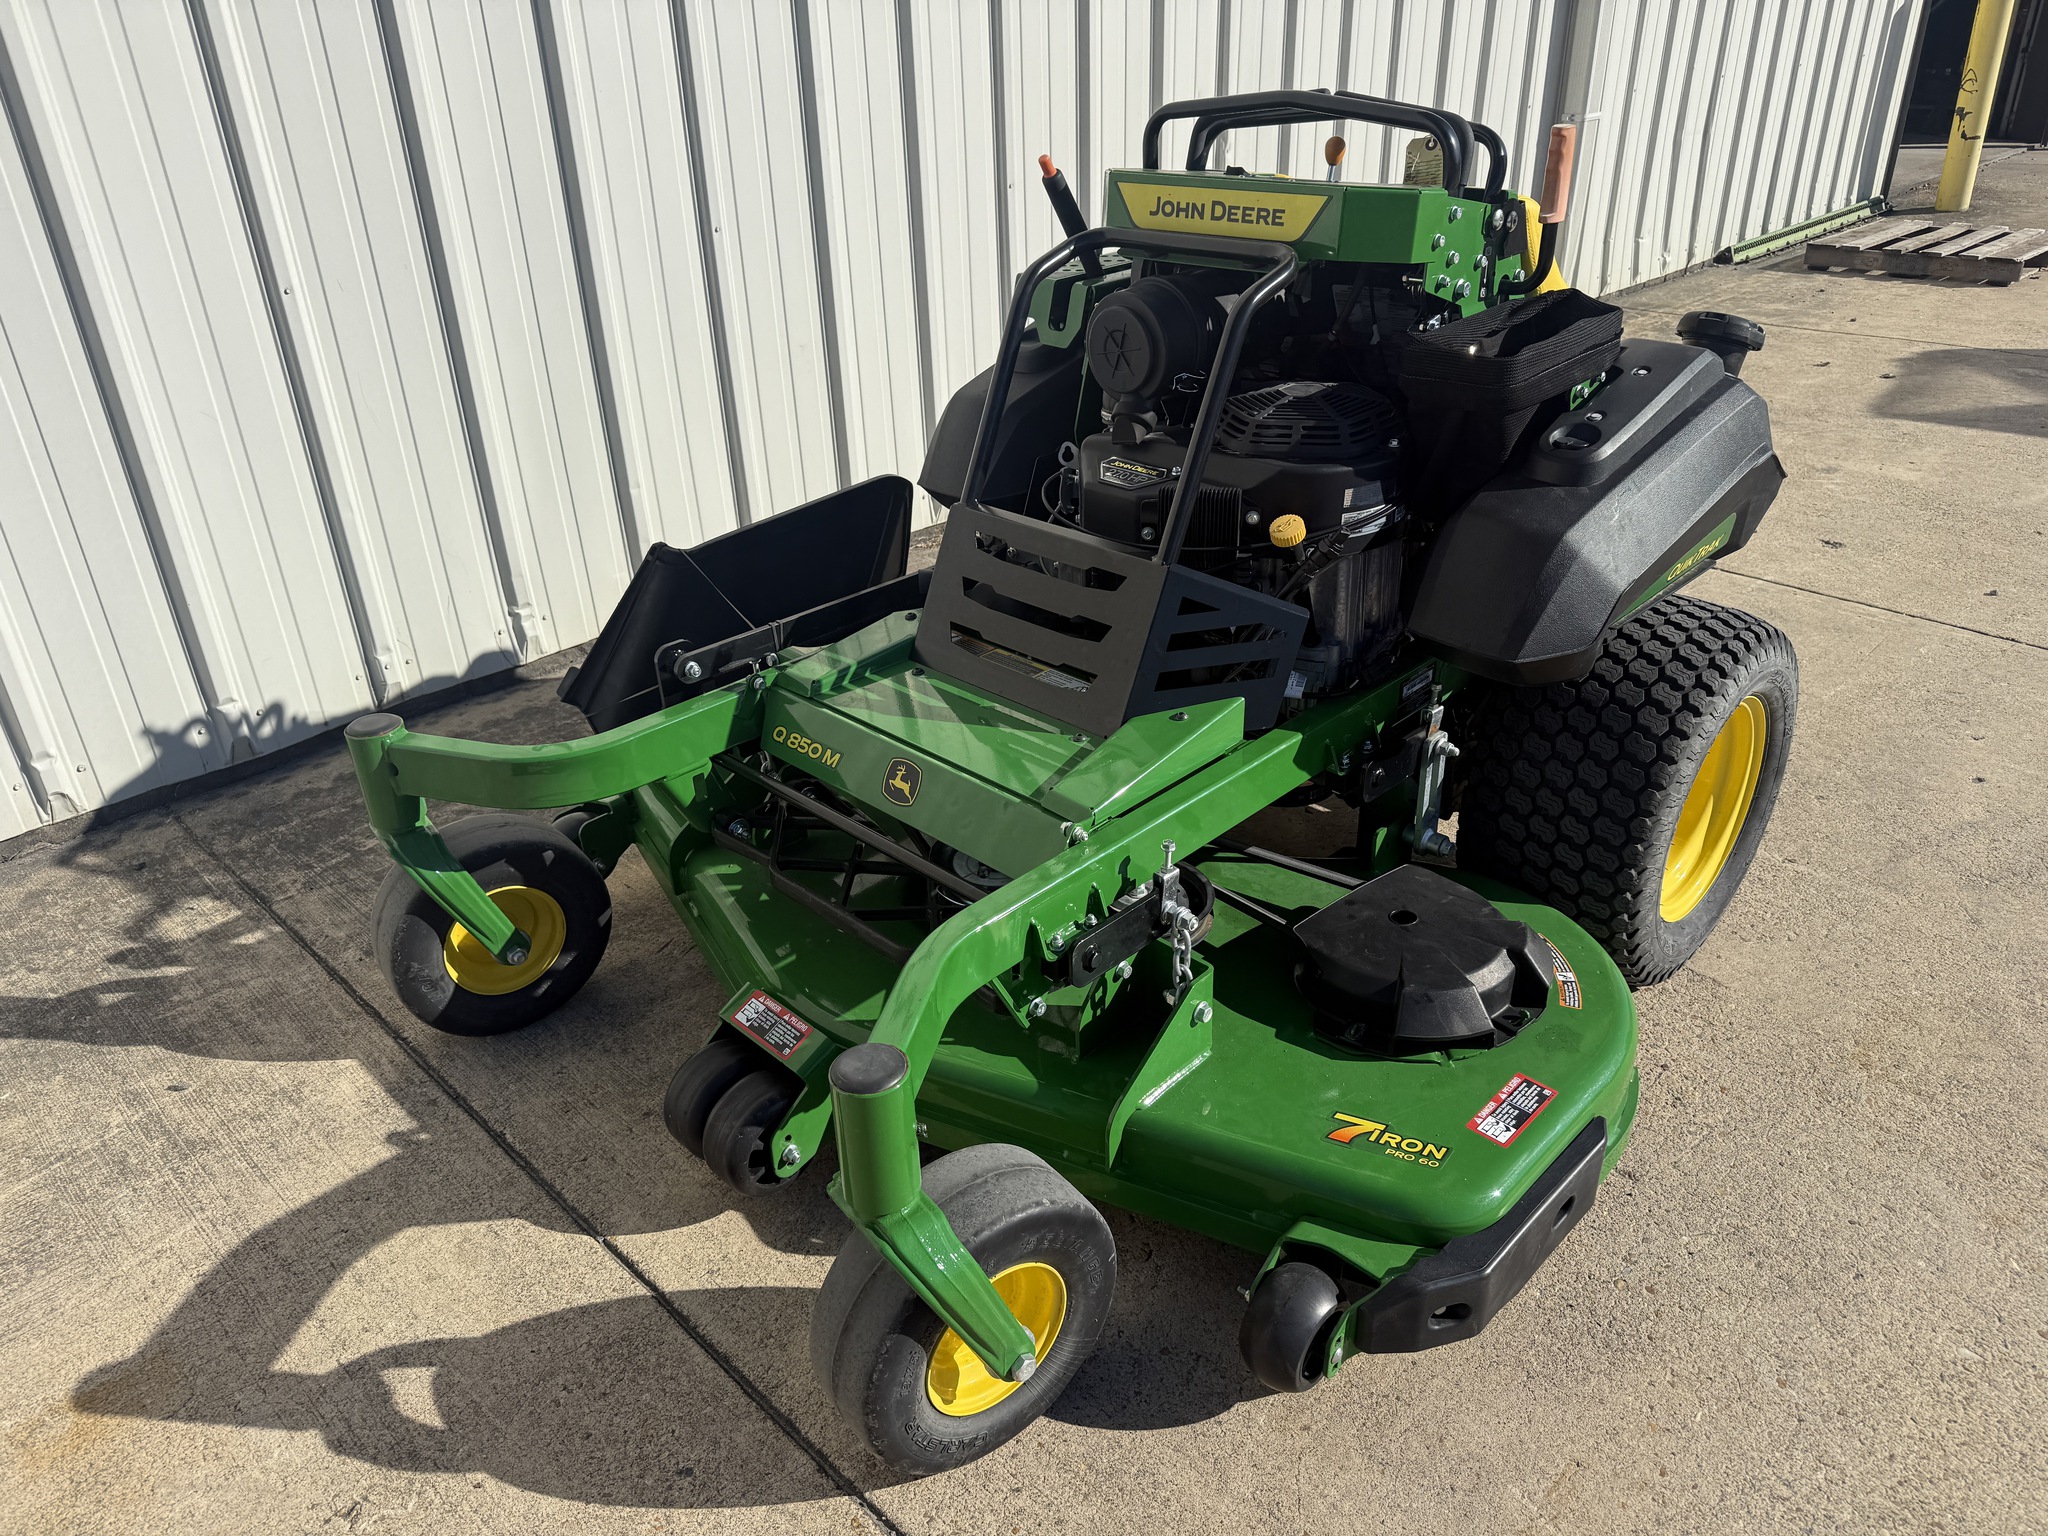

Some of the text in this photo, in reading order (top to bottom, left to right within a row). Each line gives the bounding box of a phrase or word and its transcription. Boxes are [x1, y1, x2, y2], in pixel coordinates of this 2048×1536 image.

[1149, 196, 1286, 227] JOHN DEERE
[1110, 461, 1159, 476] JOHN DEERE
[1128, 474, 1148, 483] HP
[763, 998, 782, 1013] DANGER
[788, 1016, 808, 1032] PELIGRO
[1501, 1076, 1522, 1095] PELIGRO
[1478, 1101, 1498, 1119] DANGER
[1384, 1148, 1441, 1168] PRO 60
